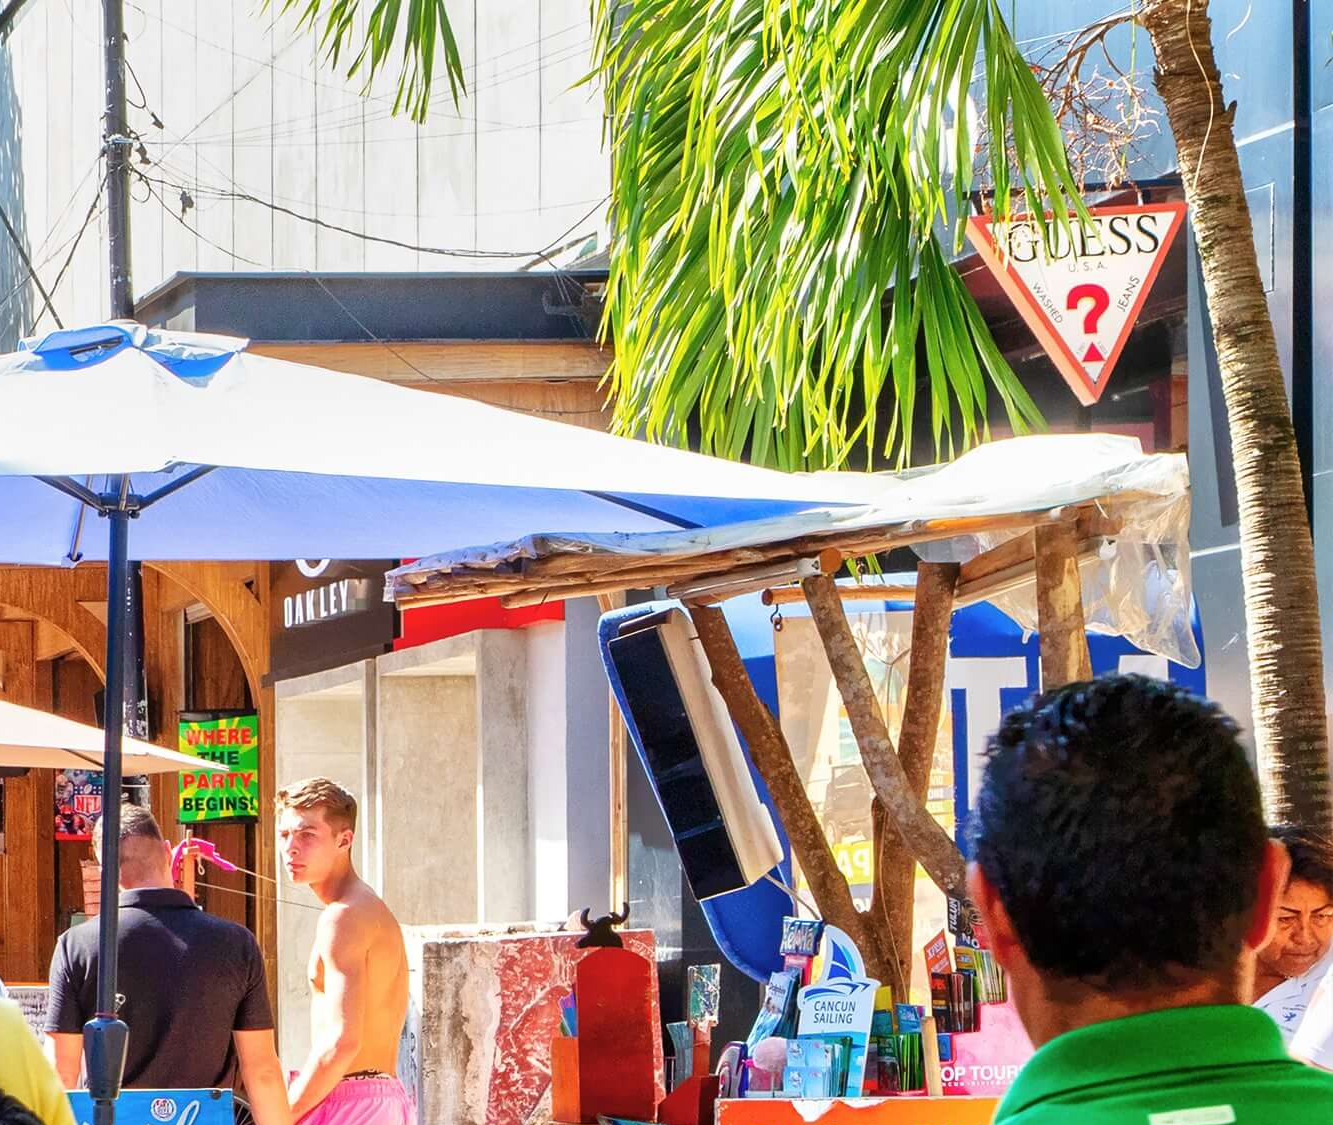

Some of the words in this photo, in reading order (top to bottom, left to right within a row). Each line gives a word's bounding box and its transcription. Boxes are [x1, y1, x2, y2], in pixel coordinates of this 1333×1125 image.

[1007, 214, 1160, 263] GUESS
[1116, 275, 1141, 312] JEANS
[1032, 282, 1064, 324] WASHED
[284, 578, 349, 628] OAKLEY
[186, 728, 252, 746] WHERE
[197, 751, 240, 766] THE
[183, 772, 253, 789] PARTY
[182, 796, 254, 812] BEGINS!
[814, 1000, 856, 1012] CANCUN
[813, 1012, 853, 1025] SAILING
